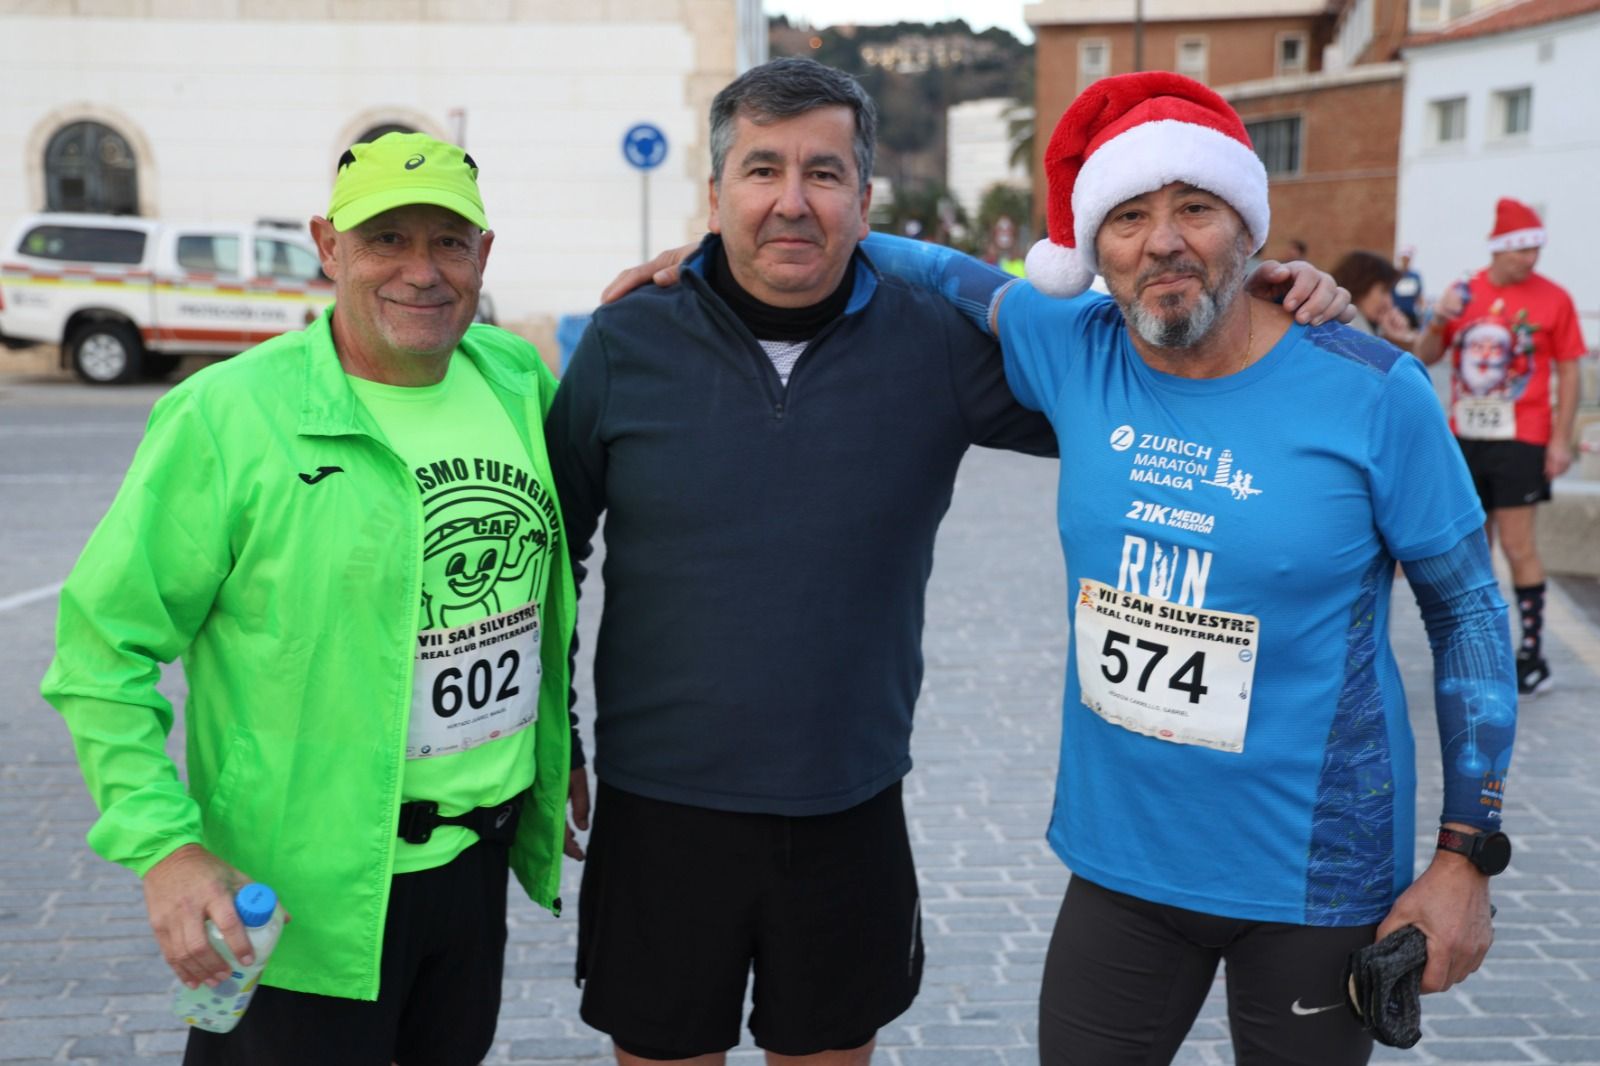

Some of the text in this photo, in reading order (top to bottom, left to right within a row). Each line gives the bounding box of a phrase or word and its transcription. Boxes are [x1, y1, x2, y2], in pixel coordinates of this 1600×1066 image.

[1138, 434, 1213, 460] ZURICH
[1133, 453, 1208, 476] MARATÓN
[1129, 467, 1193, 491] MÁLAGA
[1125, 500, 1215, 526] 21K MEDIA
[473, 519, 516, 535] CAF
[1117, 534, 1213, 609] RUN
[1096, 605, 1122, 620] REAL
[1125, 615, 1152, 628] CLUB
[1099, 588, 1256, 633] VII SAN SILVESTRE
[418, 633, 443, 647] VII
[448, 625, 475, 644] SAN
[421, 649, 451, 660] REAL
[453, 642, 477, 655] CLUB
[1100, 629, 1209, 704] 574
[432, 649, 520, 718] 602
